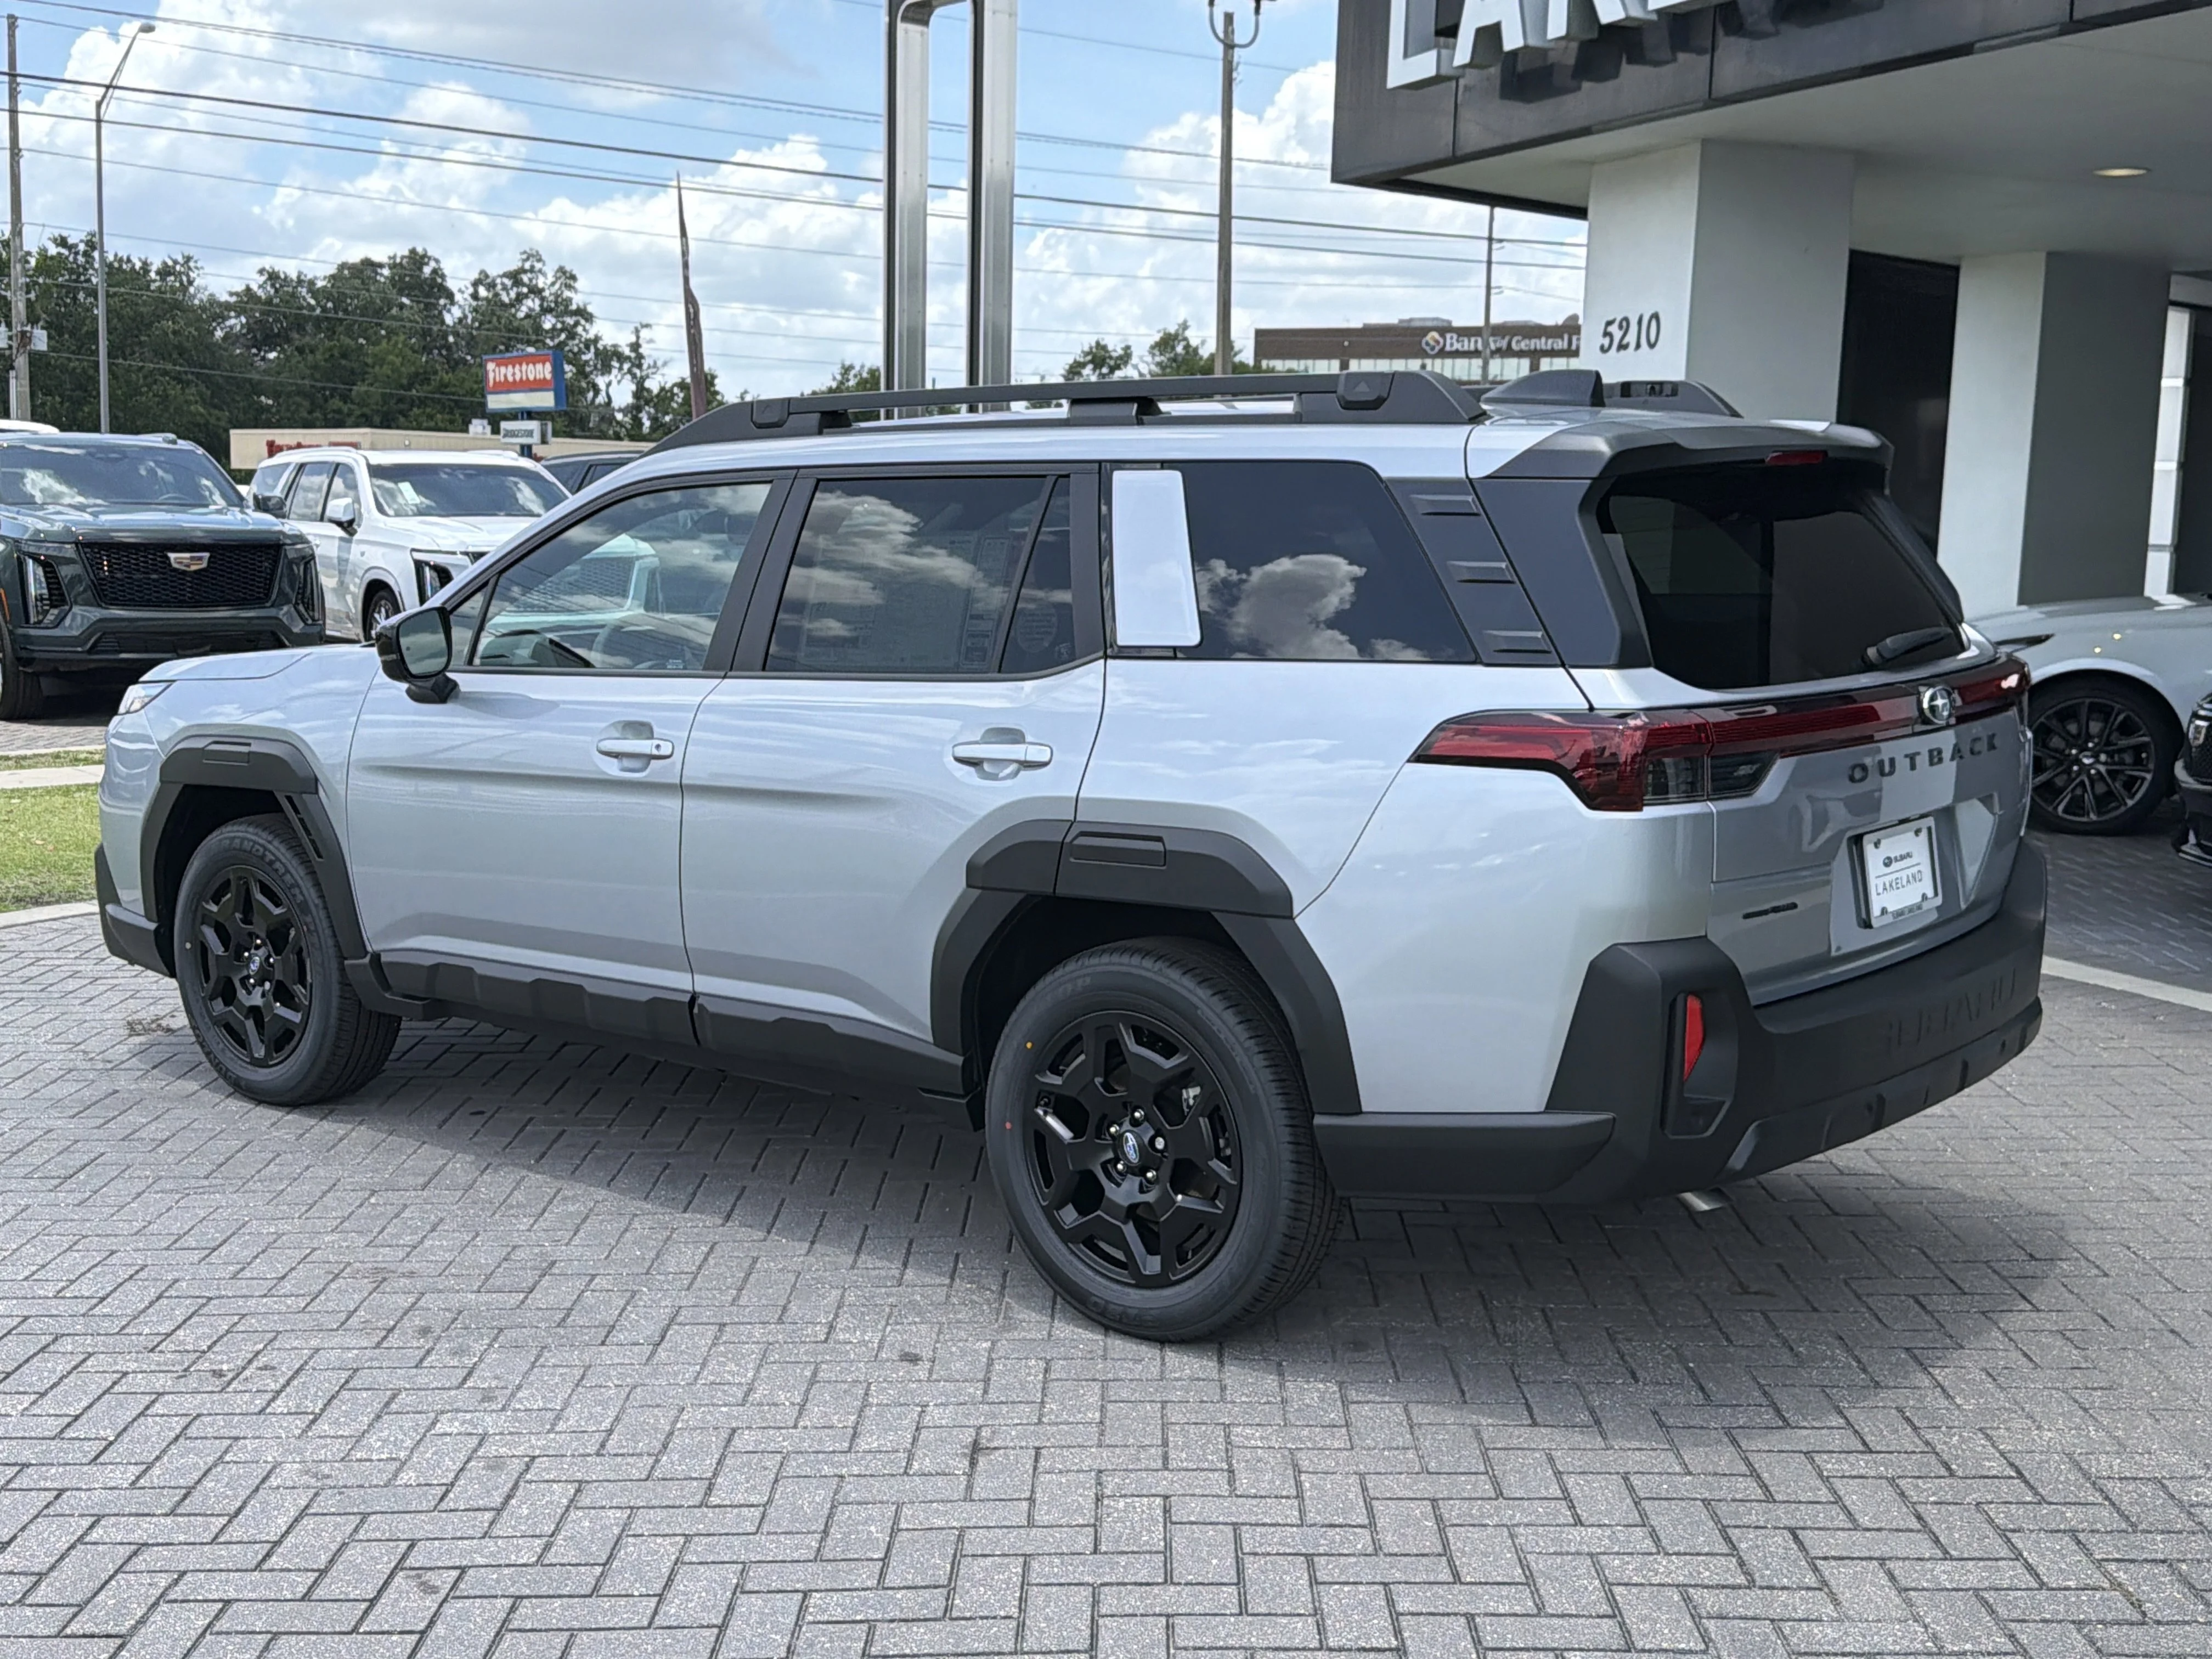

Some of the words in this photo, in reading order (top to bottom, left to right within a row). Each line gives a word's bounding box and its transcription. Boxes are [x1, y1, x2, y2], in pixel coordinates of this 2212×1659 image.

[1511, 332, 1568, 351] Central
[1599, 311, 1661, 354] 5210
[487, 362, 552, 388] Firestone
[1848, 732, 1999, 783] OUTBACK
[1875, 870, 1923, 896] LAKELAND
